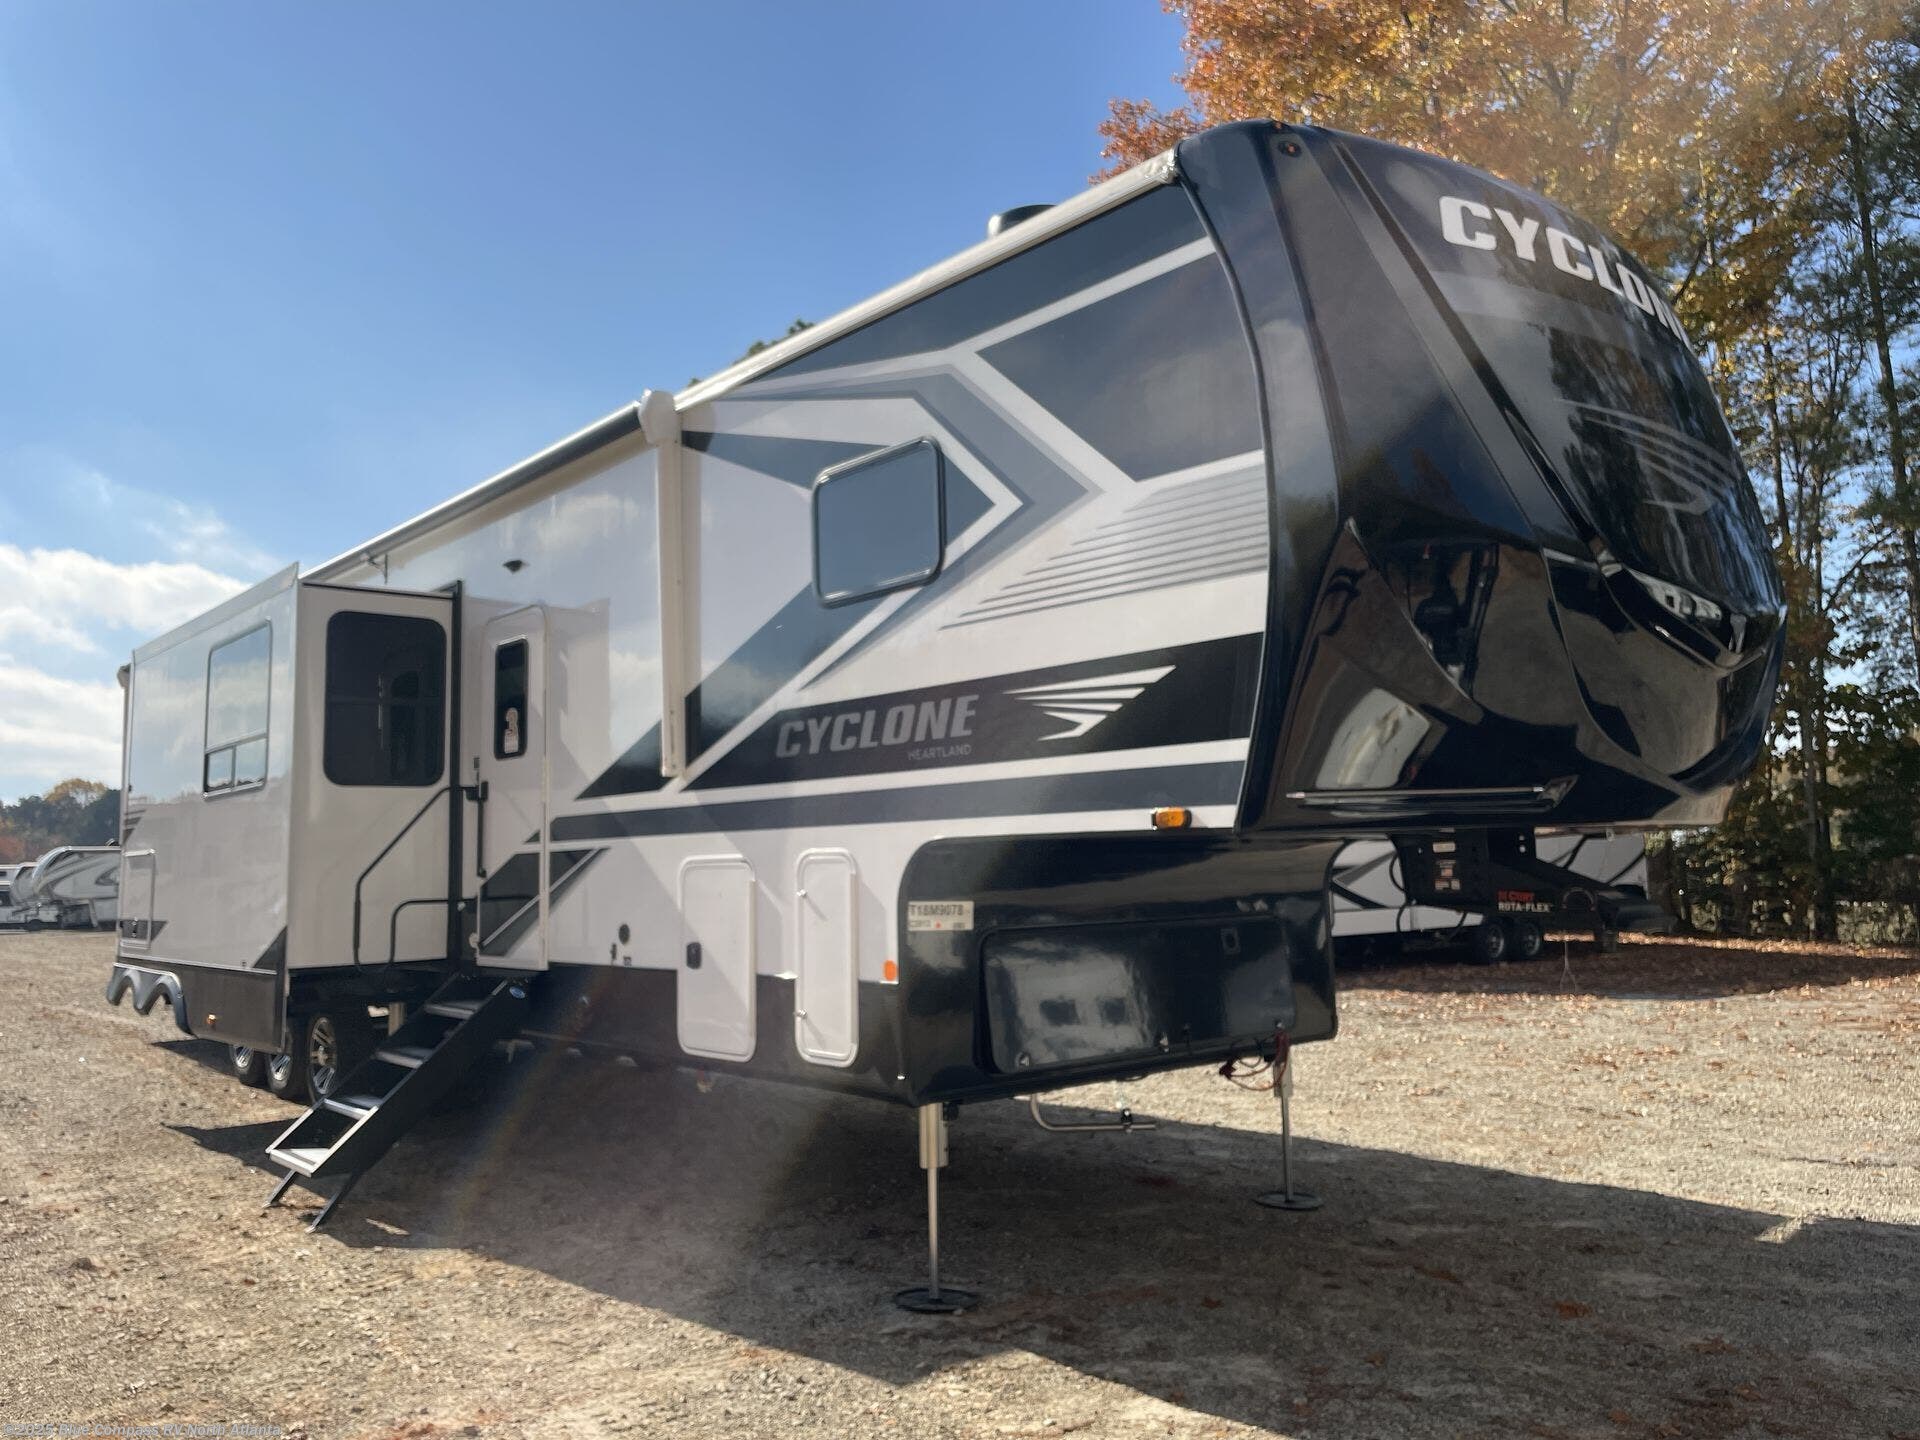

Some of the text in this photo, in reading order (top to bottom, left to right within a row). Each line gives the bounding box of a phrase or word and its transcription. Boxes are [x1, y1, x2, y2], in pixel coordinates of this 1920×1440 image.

[1438, 196, 1697, 358] CYCLON
[776, 694, 979, 759] CYCLONE
[907, 744, 972, 761] HEARTLAND
